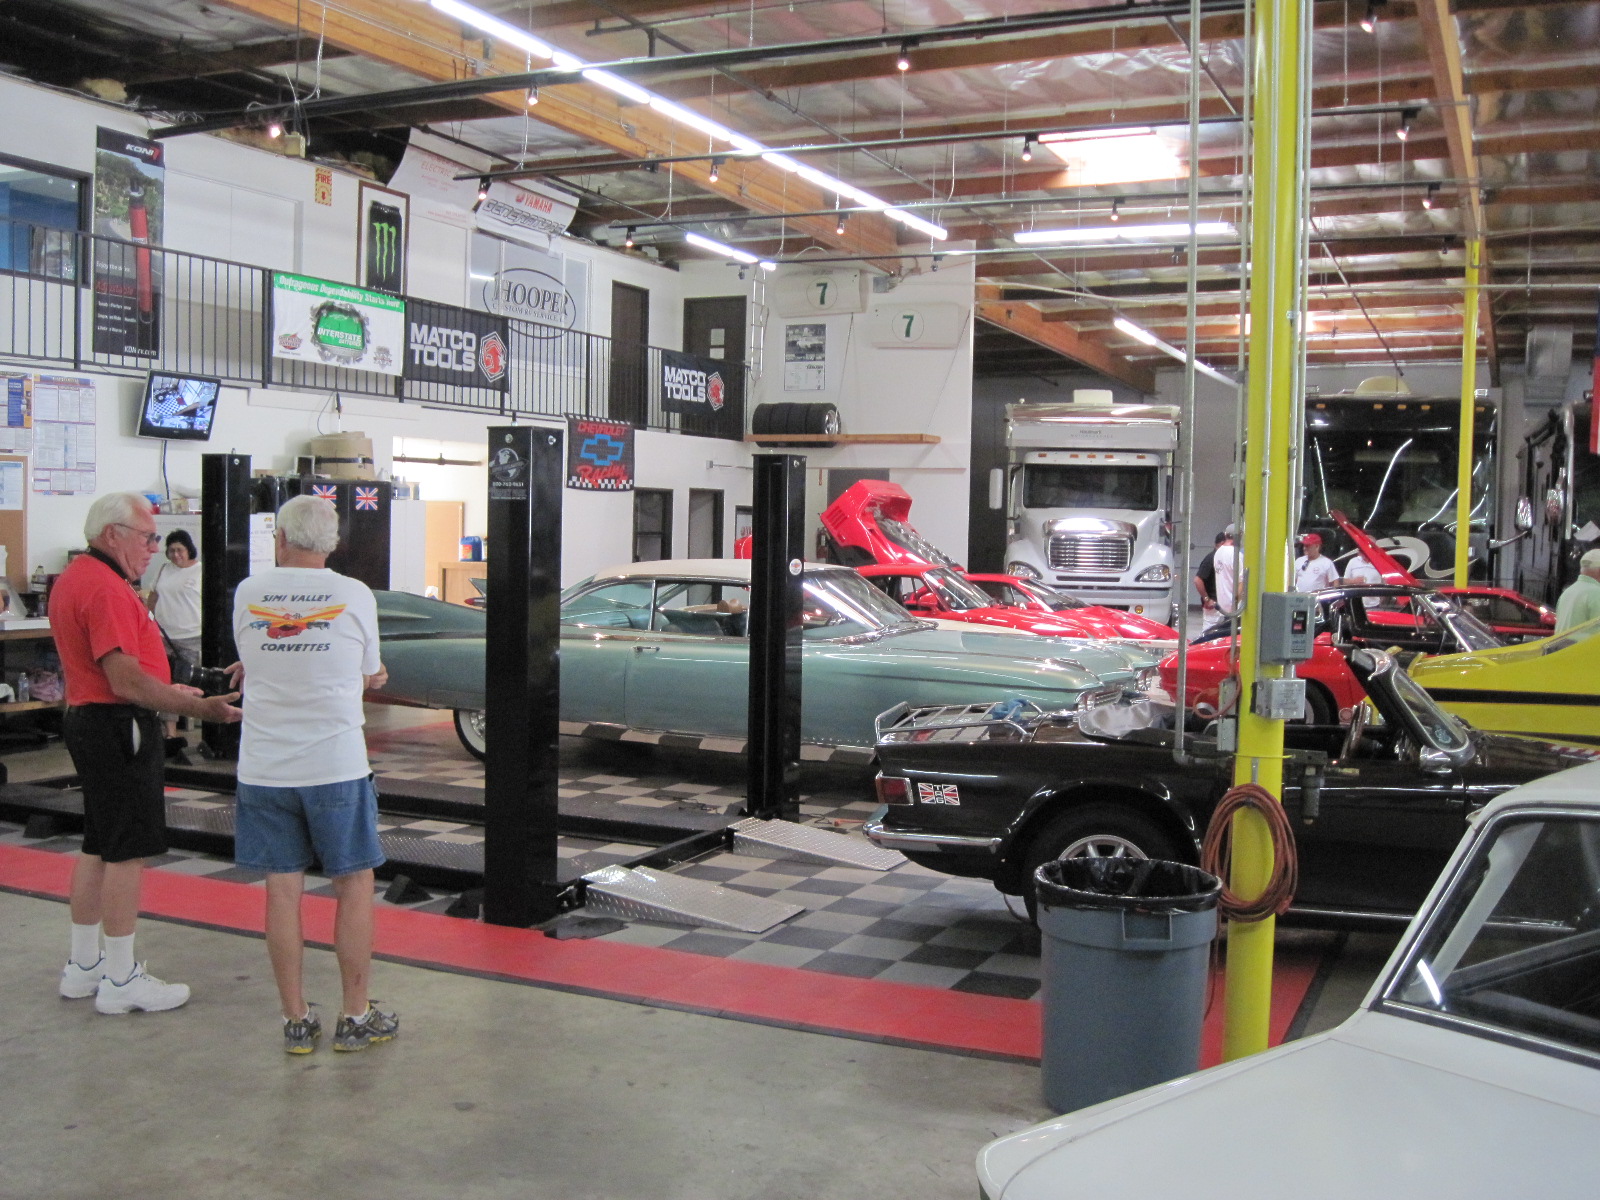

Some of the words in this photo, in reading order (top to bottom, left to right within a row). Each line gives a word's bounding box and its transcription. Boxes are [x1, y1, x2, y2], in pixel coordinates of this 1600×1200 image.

[125, 143, 154, 156] KONI
[317, 173, 332, 185] FIRE
[524, 192, 553, 214] YAMAHA
[365, 292, 386, 306] Starts
[492, 277, 569, 316] HOOPER
[816, 282, 828, 305] 7
[317, 327, 362, 344] INTERSTATE
[410, 322, 476, 352] MATCO
[902, 315, 914, 338] 7
[410, 343, 476, 372] TOOLS
[664, 365, 706, 387] MATCO
[664, 381, 706, 403] TOOLS
[577, 421, 627, 436] CHEVROLET
[261, 594, 288, 603] SIMI
[291, 594, 333, 602] VALLEY
[260, 643, 331, 652] CORVETTES
